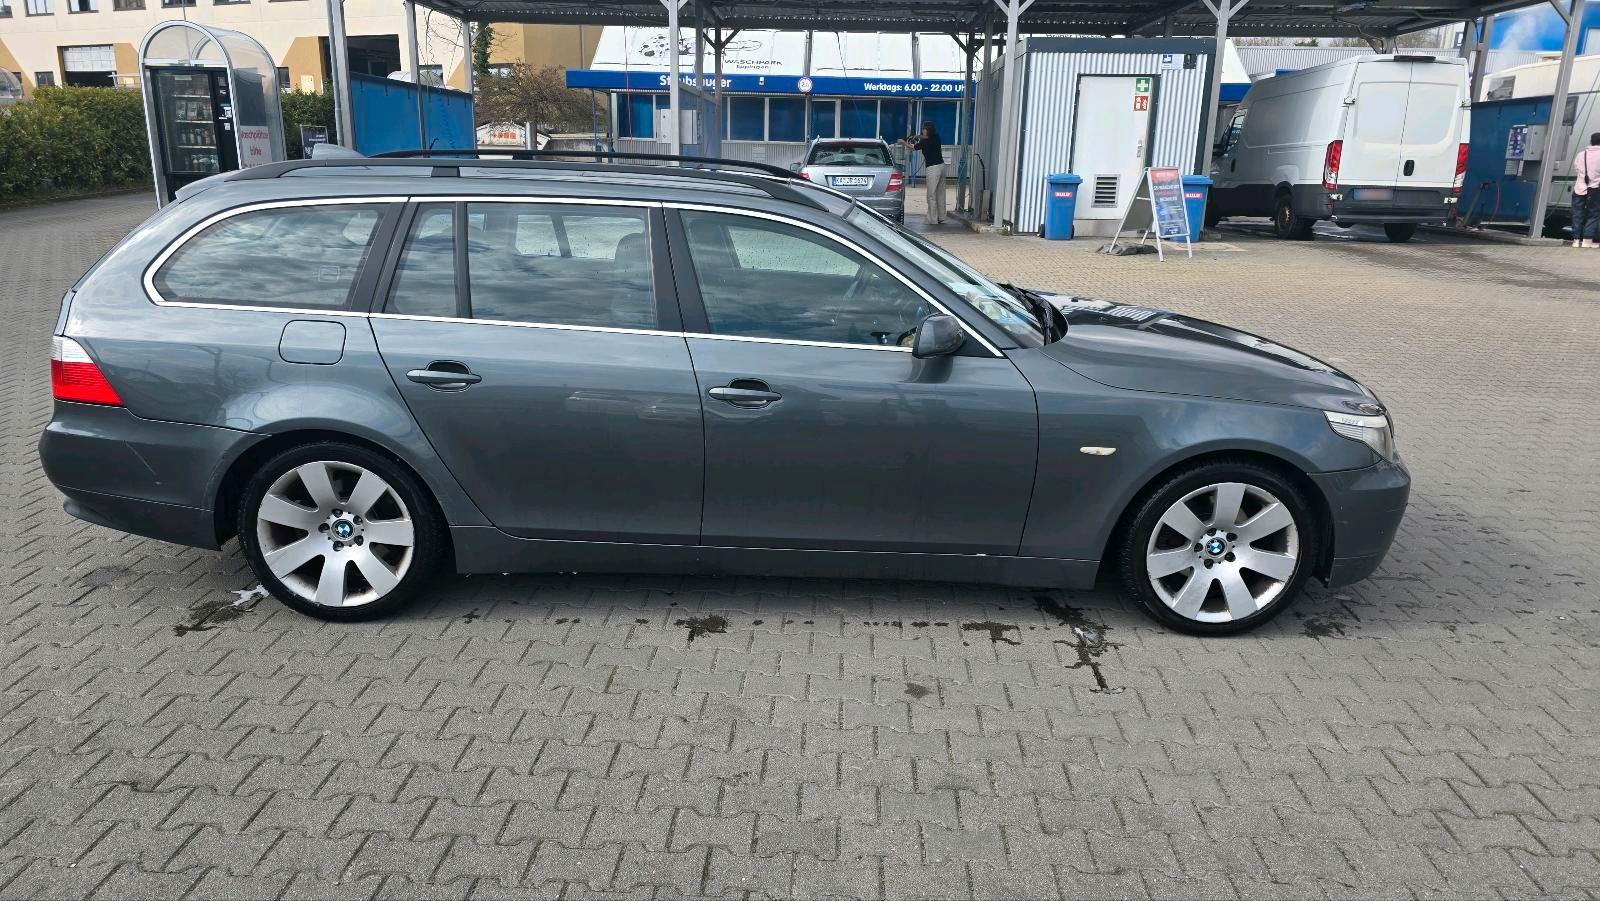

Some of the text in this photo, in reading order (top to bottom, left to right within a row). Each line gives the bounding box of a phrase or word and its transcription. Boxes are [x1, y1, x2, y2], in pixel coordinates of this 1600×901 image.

[863, 82, 903, 93] Werktags:
[904, 83, 923, 92] 6.00
[930, 83, 953, 92] 22.00
